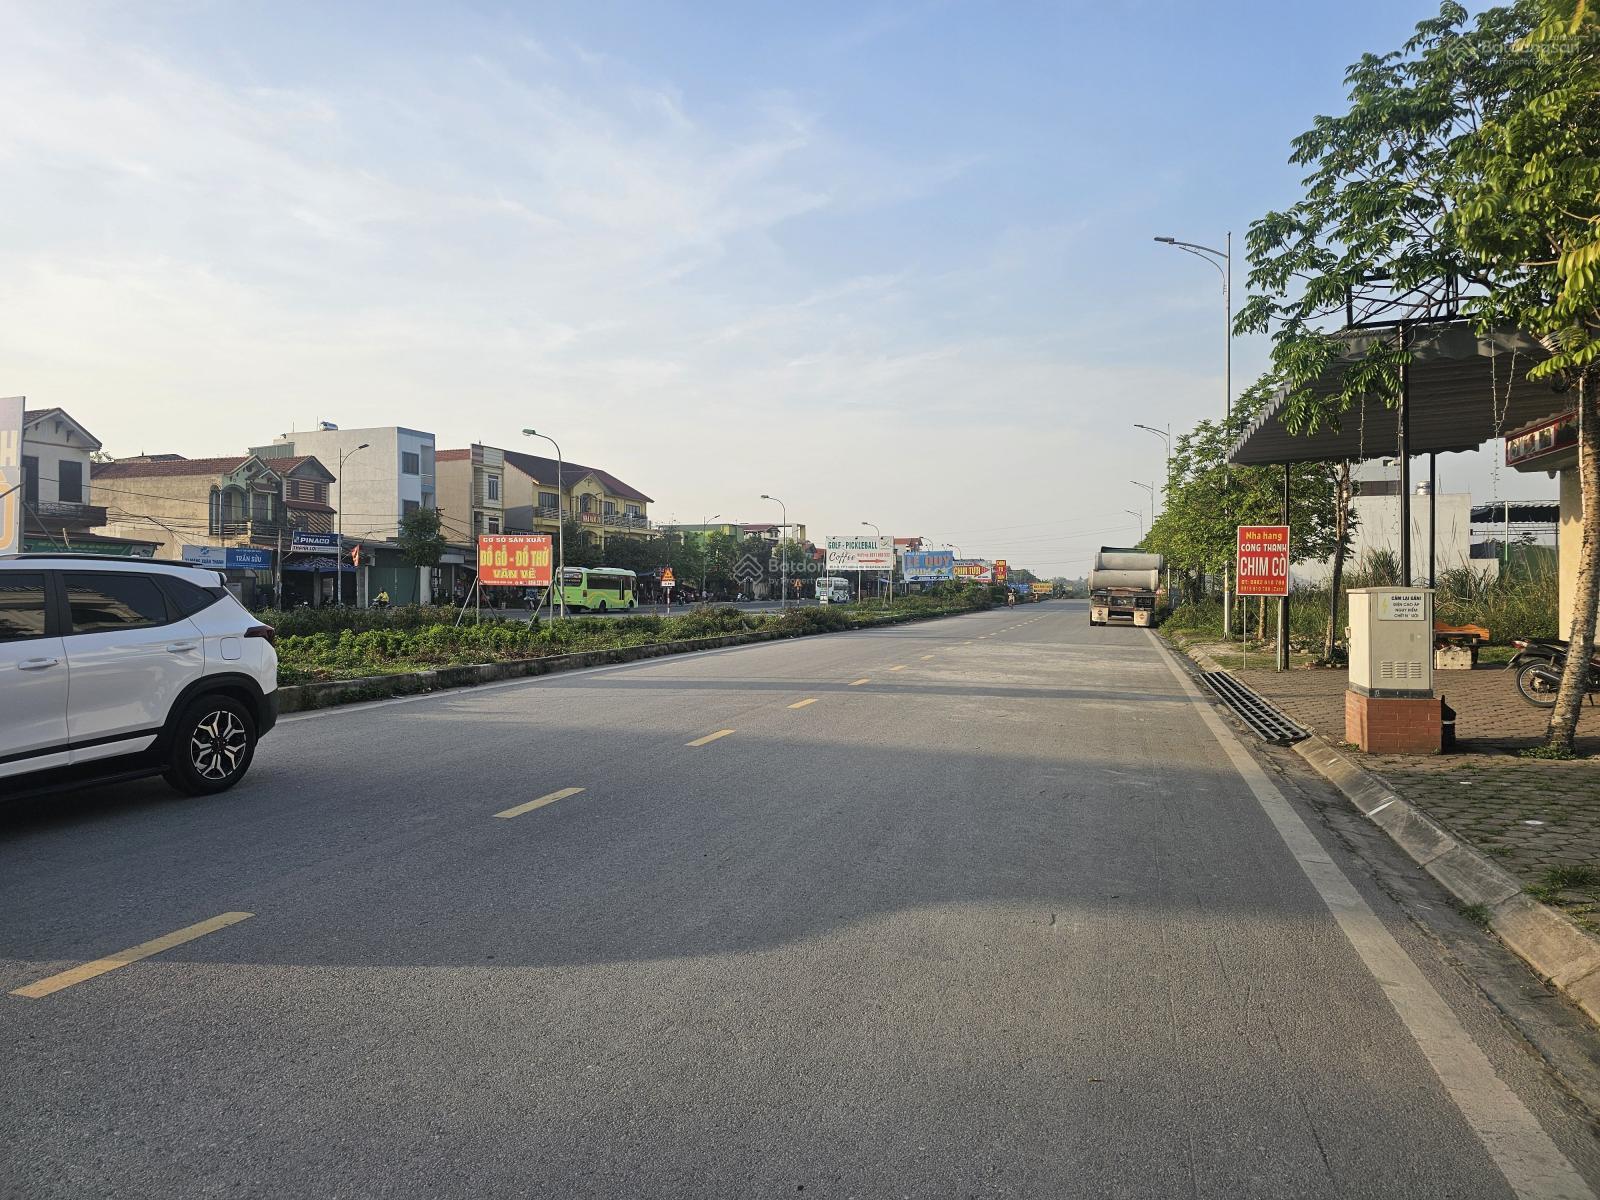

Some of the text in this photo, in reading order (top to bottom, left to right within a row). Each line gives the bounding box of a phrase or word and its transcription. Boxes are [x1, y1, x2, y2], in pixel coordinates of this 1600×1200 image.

[300, 536, 330, 544] PINACO
[828, 541, 841, 549] GOLF
[845, 541, 878, 550] PICKLEBALL
[829, 551, 856, 564] Coffee
[1240, 553, 1287, 577] CHIM CÒ
